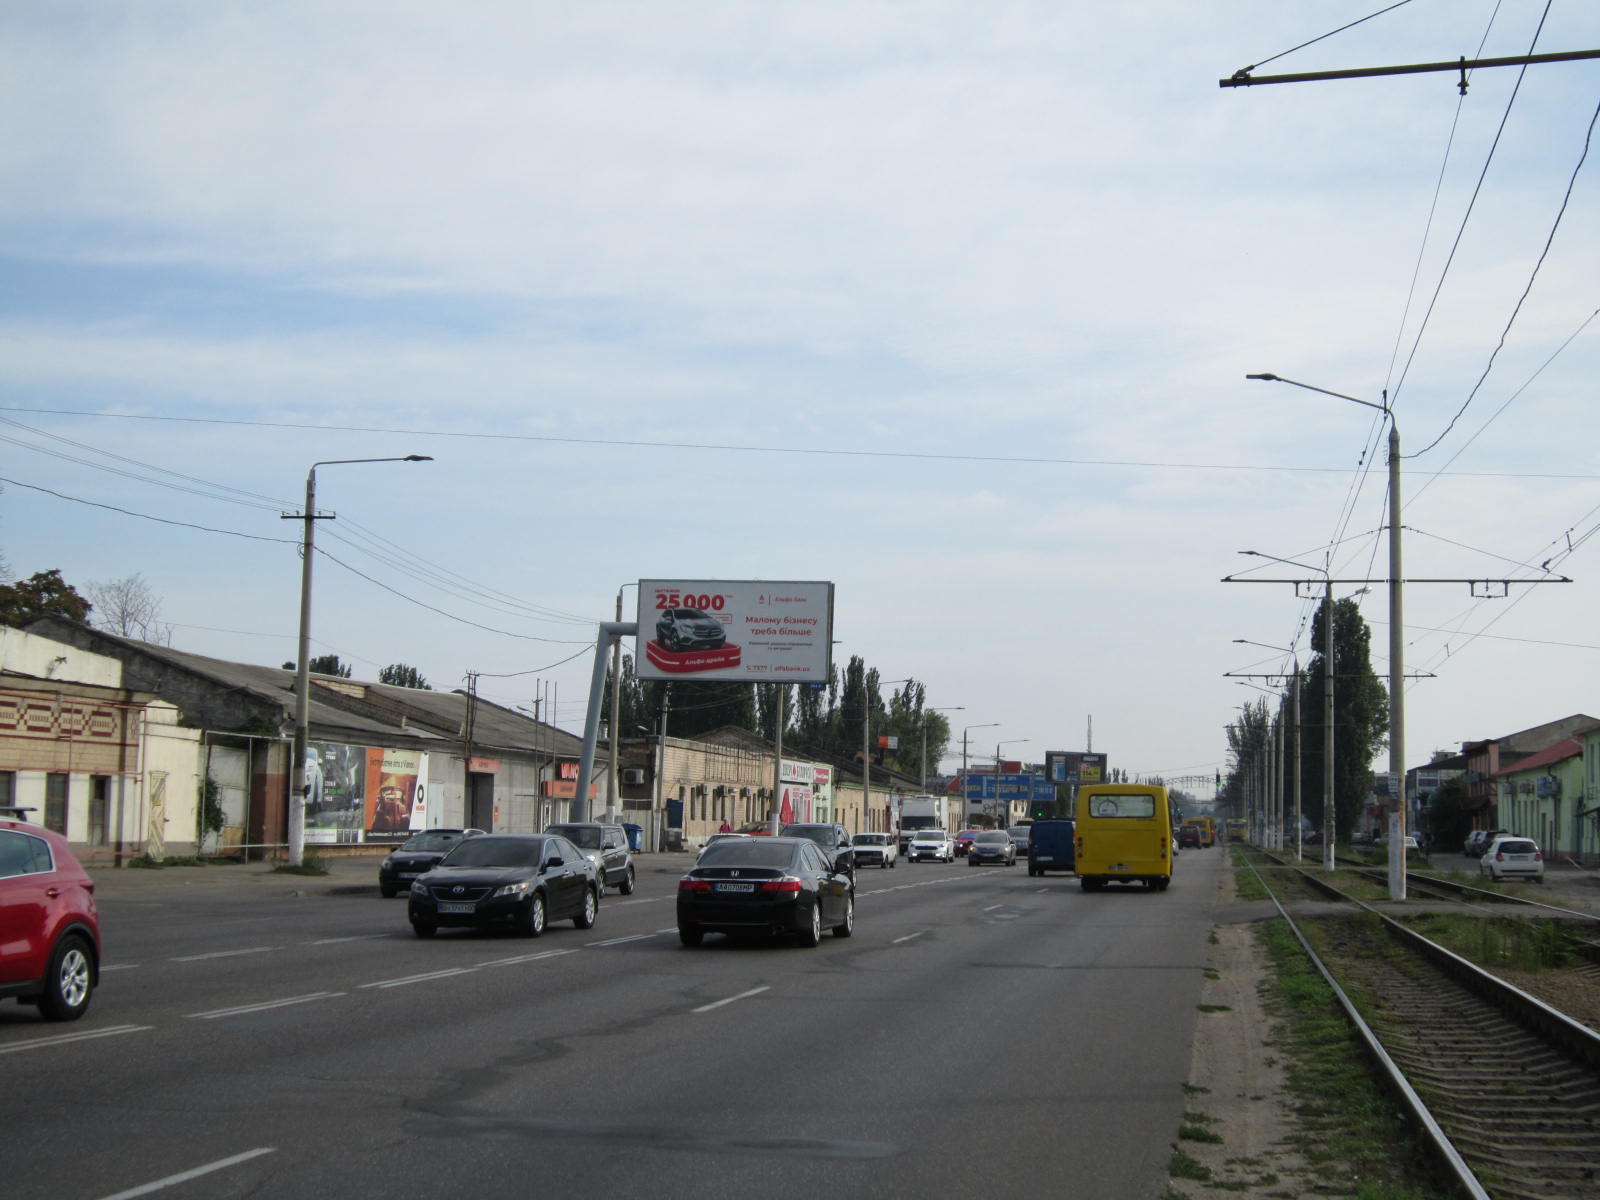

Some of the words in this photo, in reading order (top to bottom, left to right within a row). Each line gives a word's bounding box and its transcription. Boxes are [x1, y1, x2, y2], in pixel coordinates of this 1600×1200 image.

[745, 615, 782, 626] Малому
[783, 615, 818, 627] бізнесу
[750, 626, 777, 636] треба
[778, 626, 813, 637] більше
